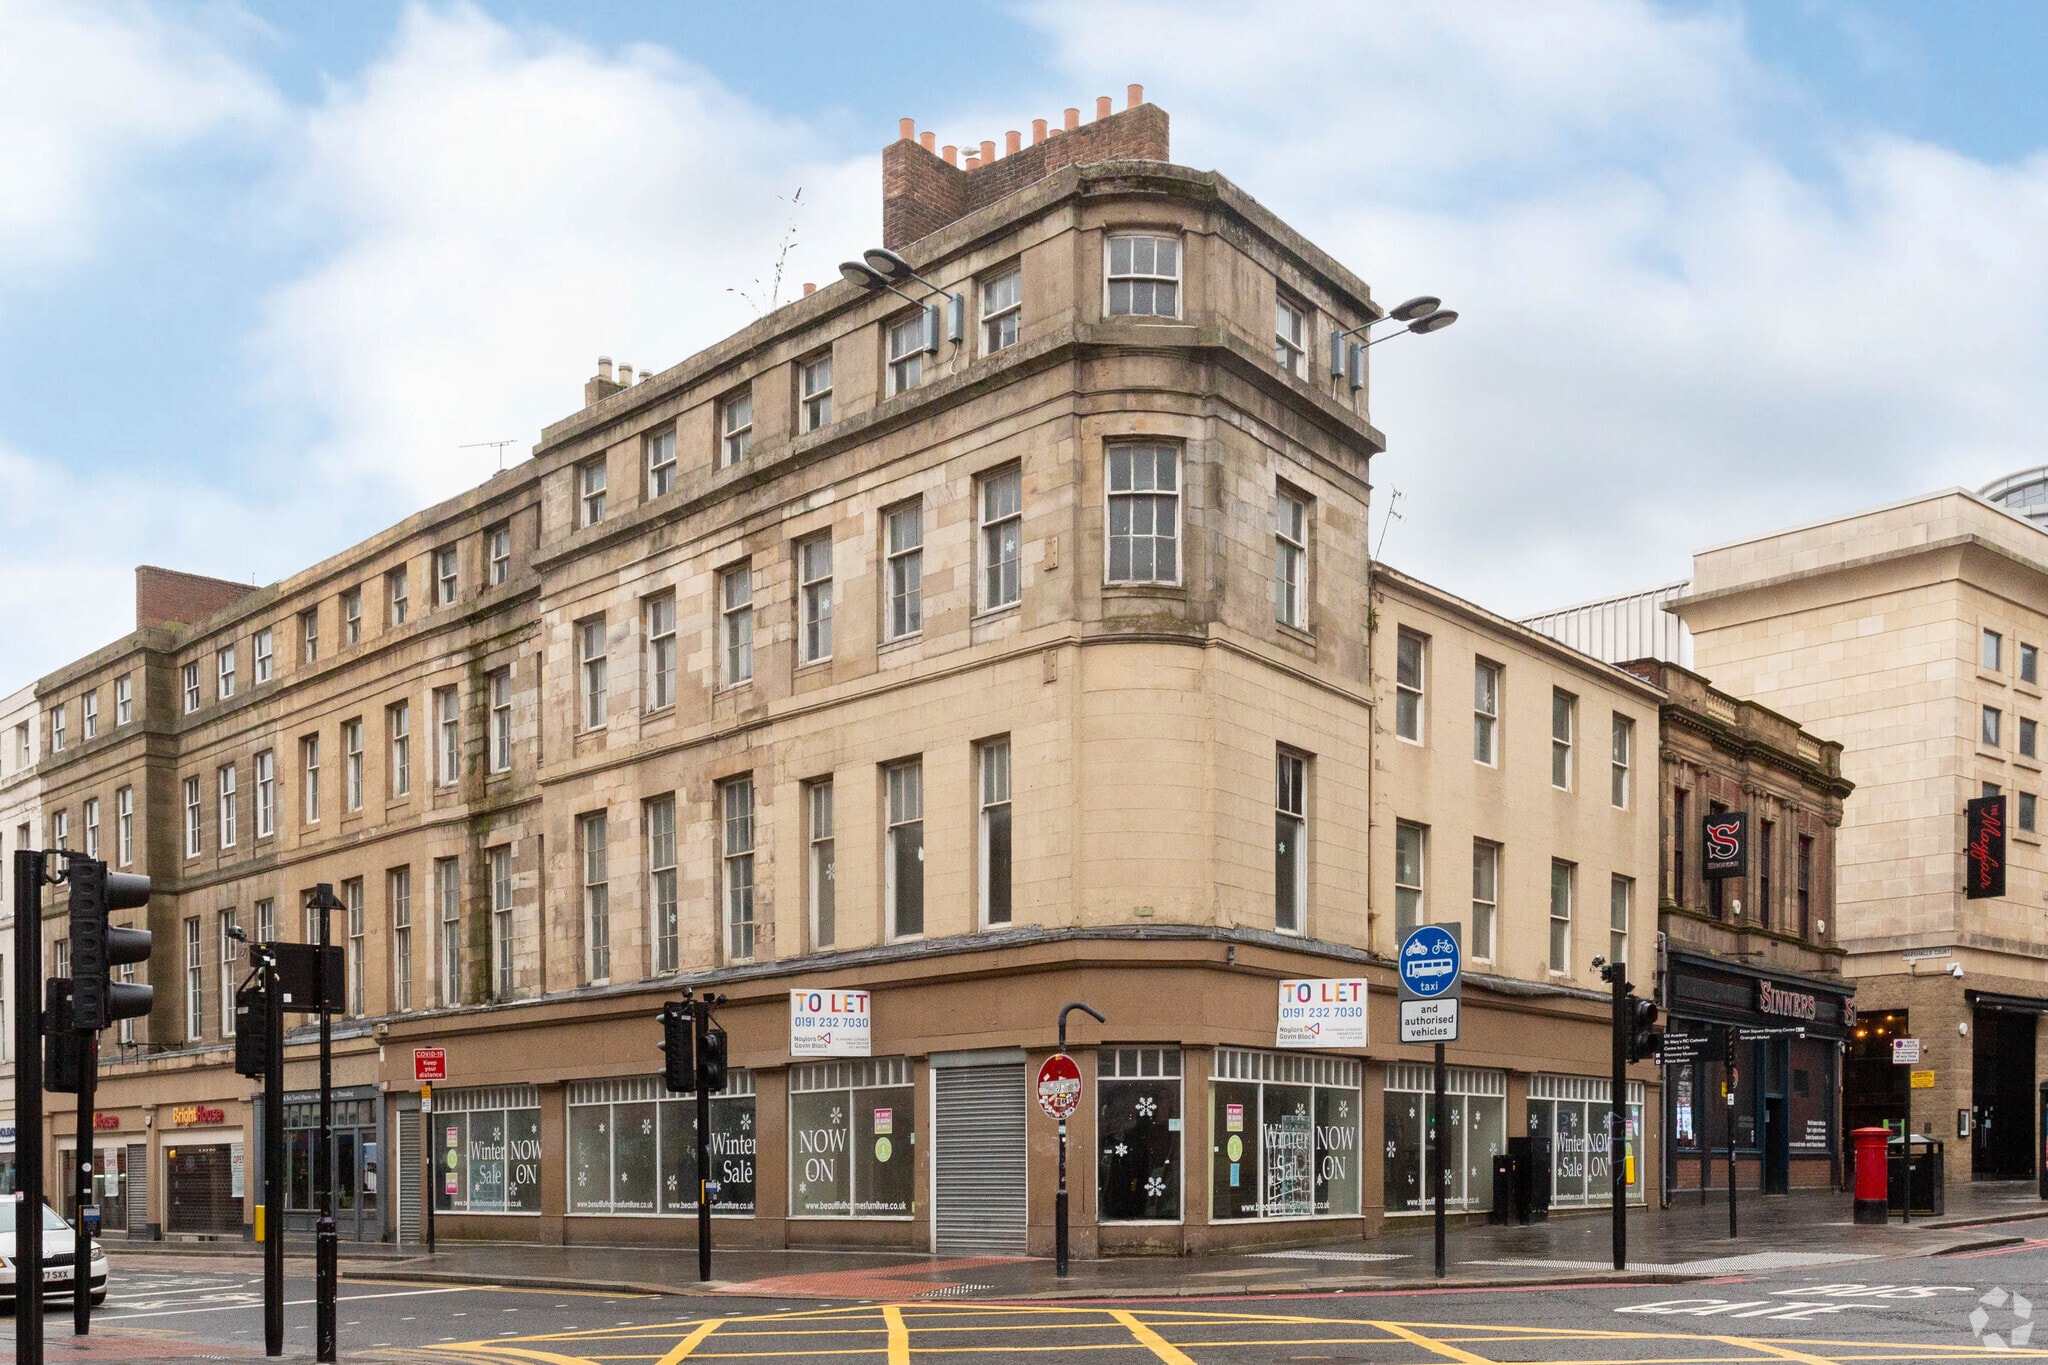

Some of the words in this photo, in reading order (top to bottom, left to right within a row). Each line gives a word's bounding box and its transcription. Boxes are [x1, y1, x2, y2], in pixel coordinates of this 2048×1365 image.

[1969, 807, 2001, 889] Mayfair
[1283, 983, 1312, 1003] TO
[1322, 982, 1362, 1003] LET
[1420, 981, 1439, 992] taxi
[795, 993, 822, 1013] TO
[831, 993, 868, 1013] LET
[1420, 1004, 1438, 1014] and
[1760, 979, 1816, 1020] SINNERS
[794, 1016, 816, 1027] 0191
[819, 1017, 839, 1028] 232
[843, 1017, 869, 1028] 7030
[1282, 1007, 1304, 1018] 0191
[1308, 1007, 1330, 1018] 232
[1334, 1006, 1363, 1018] 7030
[1404, 1014, 1454, 1026] authorised
[1410, 1027, 1448, 1037] vehicles
[172, 1106, 226, 1127] BrightHouse
[710, 1132, 757, 1156] Winter
[799, 1128, 847, 1154] NOW
[1263, 1123, 1311, 1150] Winter
[1316, 1125, 1355, 1150] NOW
[1556, 1132, 1585, 1153] Winter
[470, 1140, 505, 1161] Winter
[510, 1139, 542, 1161] NOW
[479, 1164, 502, 1186] Sale
[516, 1163, 537, 1185] ON
[723, 1159, 754, 1184] Sale
[805, 1158, 835, 1182] ON
[1322, 1155, 1347, 1180] ON
[1562, 1156, 1583, 1178] Sale
[1591, 1156, 1608, 1177] ON
[52, 1271, 68, 1279] SXX
